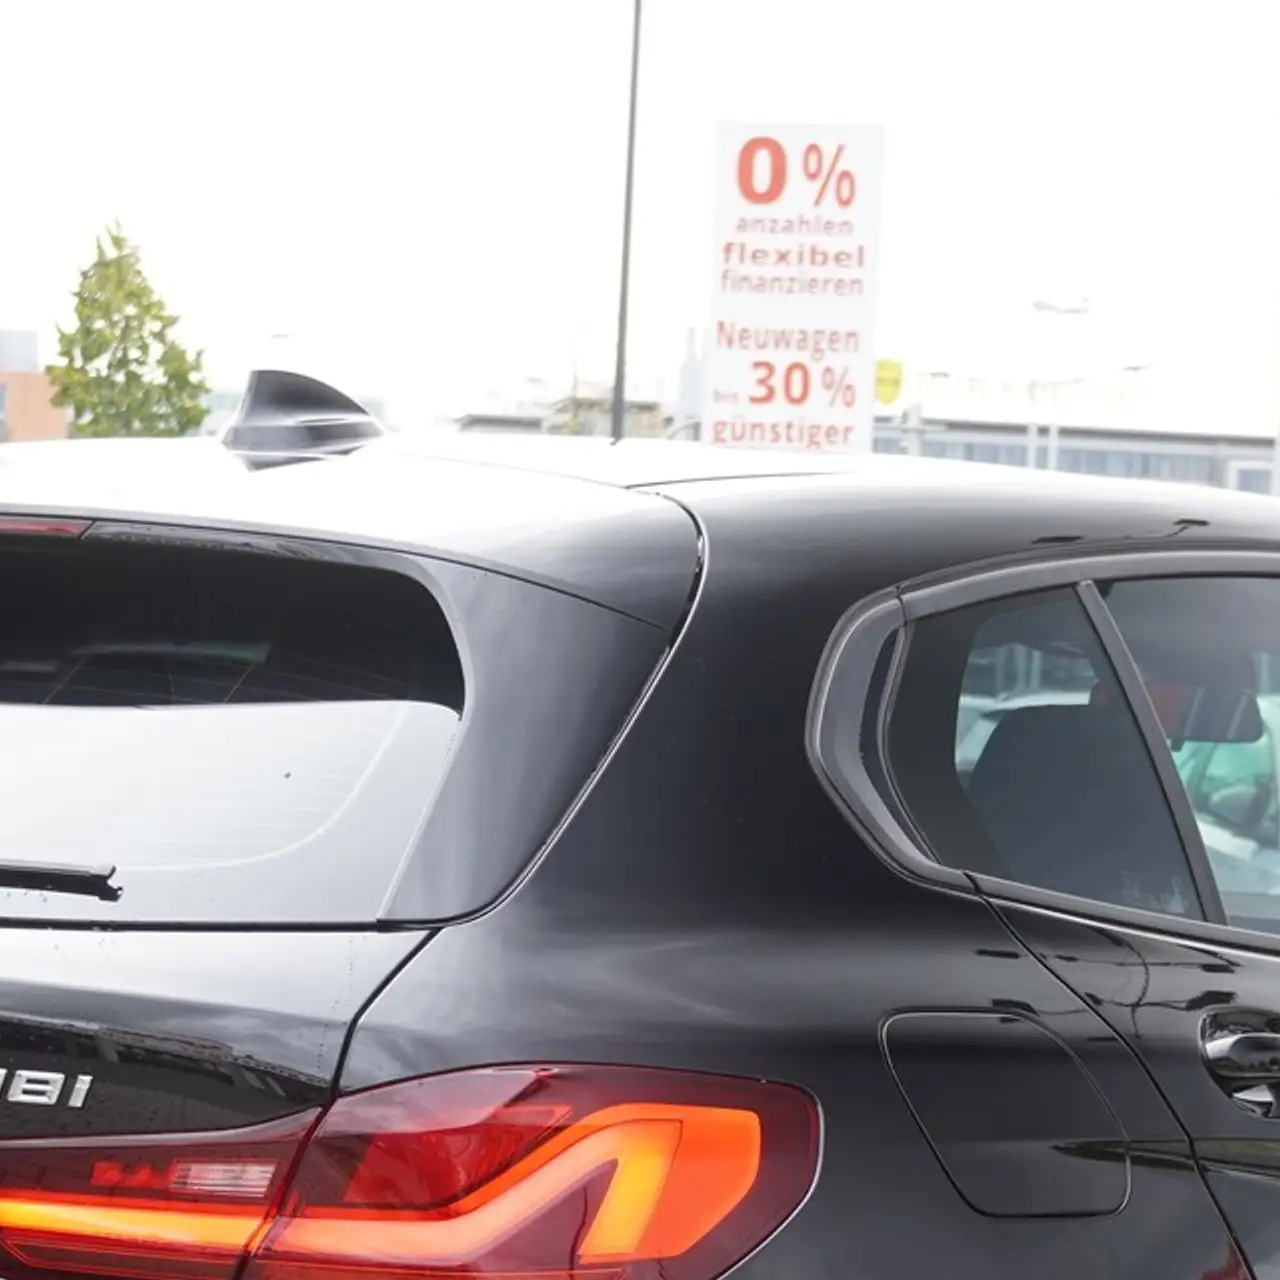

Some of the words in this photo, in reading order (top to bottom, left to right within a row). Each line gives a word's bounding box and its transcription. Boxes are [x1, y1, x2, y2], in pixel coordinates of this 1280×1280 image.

[735, 215, 854, 236] anzahlen
[723, 241, 865, 268] flexibel
[721, 269, 864, 297] finanzieren
[716, 319, 859, 361] Neuwagen
[712, 415, 855, 449] günstiger
